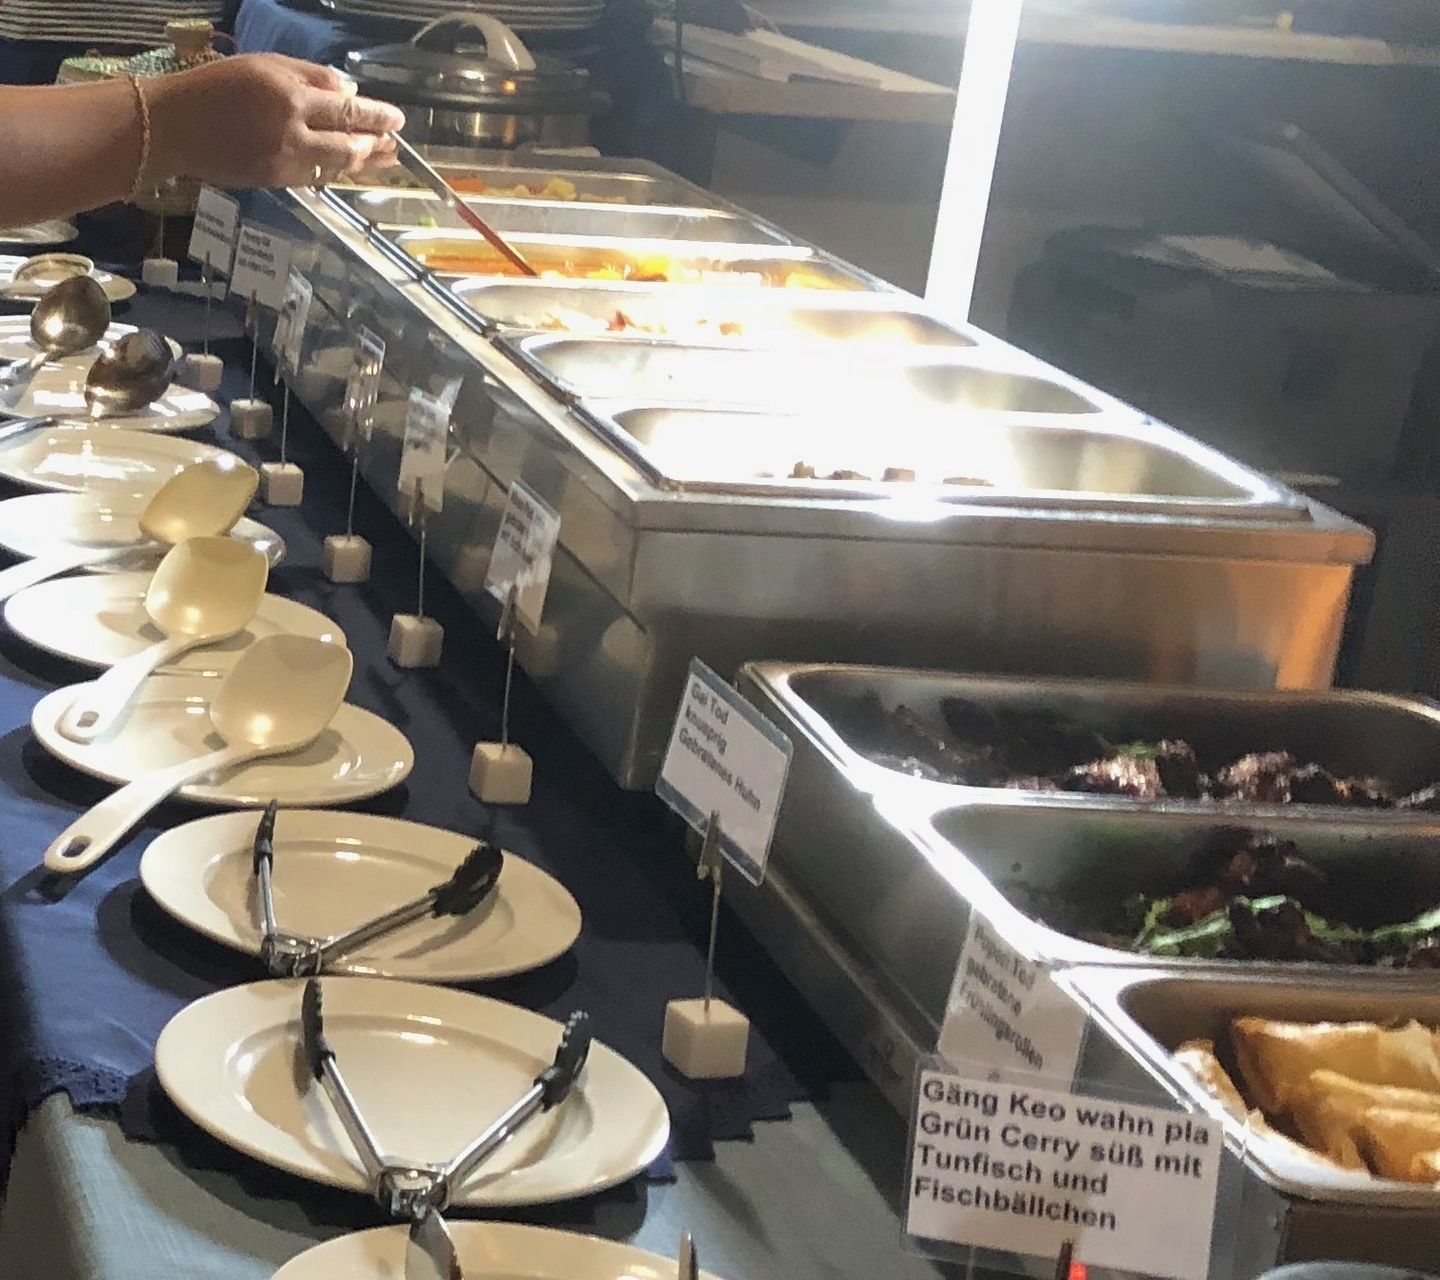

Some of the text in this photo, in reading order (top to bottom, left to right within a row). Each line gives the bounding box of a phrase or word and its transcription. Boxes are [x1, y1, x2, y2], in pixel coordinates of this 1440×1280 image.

[710, 698, 730, 726] Tod
[923, 1078, 1209, 1145] Gäng Keo wahn pla
[918, 1143, 1108, 1195] Tunfisch und
[920, 1111, 1202, 1179] Grün Cerry süß mit
[915, 1175, 1116, 1231] Fischbällchen
